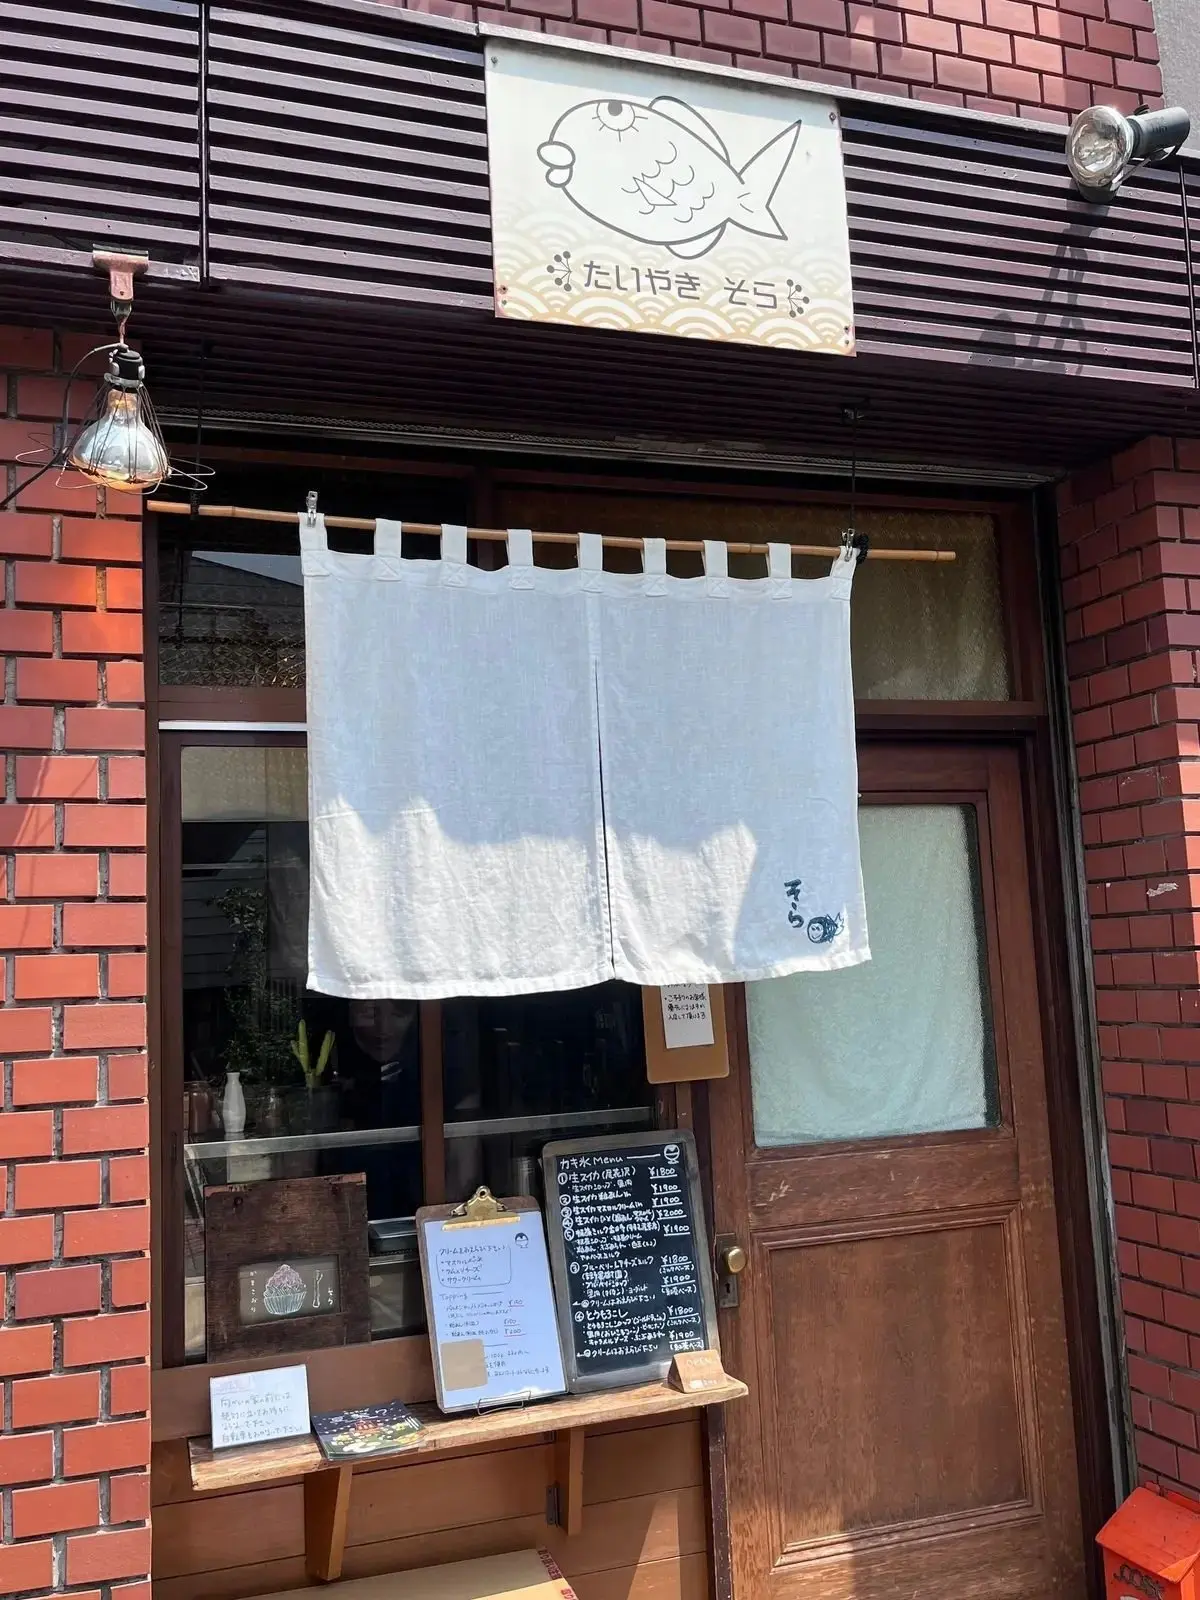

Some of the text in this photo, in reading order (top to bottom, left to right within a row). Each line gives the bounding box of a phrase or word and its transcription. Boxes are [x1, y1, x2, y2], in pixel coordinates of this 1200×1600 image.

[583, 260, 778, 309] たいやき そら
[784, 879, 804, 928] そら
[560, 1157, 623, 1169] カキ氷 Menu
[648, 1167, 675, 1176] ¥1800
[651, 1184, 678, 1192] ¥1900
[652, 1197, 680, 1206] ¥1900
[656, 1209, 683, 1218] ¥2000
[663, 1224, 690, 1233] ¥1900
[660, 1255, 689, 1264] ¥1800
[663, 1275, 691, 1284] ¥1900
[667, 1305, 694, 1316] ¥1800
[669, 1330, 695, 1340] ¥1900
